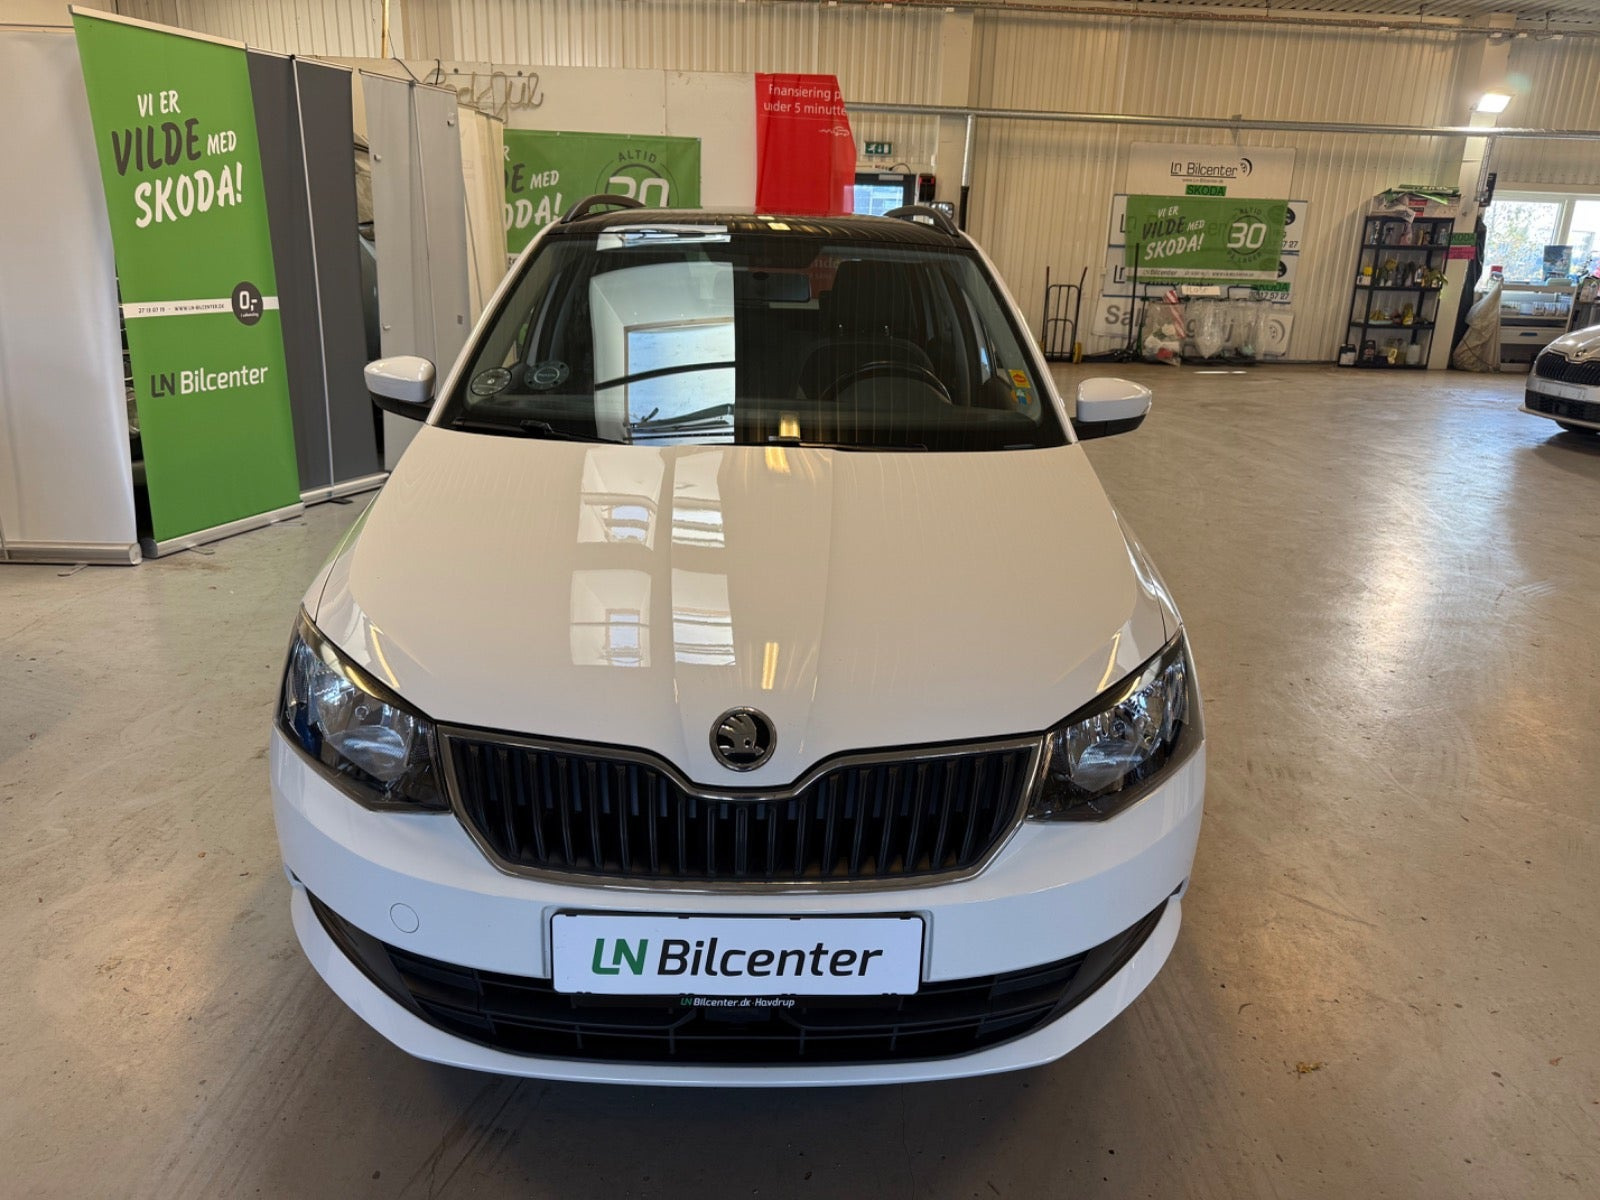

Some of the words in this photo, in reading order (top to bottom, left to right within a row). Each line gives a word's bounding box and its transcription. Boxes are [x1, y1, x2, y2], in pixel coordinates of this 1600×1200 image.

[137, 92, 154, 118] VI
[159, 89, 181, 114] ER
[794, 102, 801, 114] 5
[111, 117, 202, 177] VILDE
[207, 130, 237, 156] MED
[530, 169, 560, 190] MED
[1187, 161, 1238, 177] Bilcenter
[134, 161, 243, 228] SKODA!
[1186, 184, 1226, 196] SKODA
[1168, 205, 1179, 217] ER
[1142, 215, 1187, 241] VILDE
[1187, 219, 1205, 232] MED
[1227, 222, 1267, 249] 30
[1144, 232, 1205, 261] SKODA!
[151, 371, 175, 399] LN
[180, 365, 269, 395] Bilcenter
[591, 937, 649, 976] LN
[656, 937, 884, 977] Bilcenter
